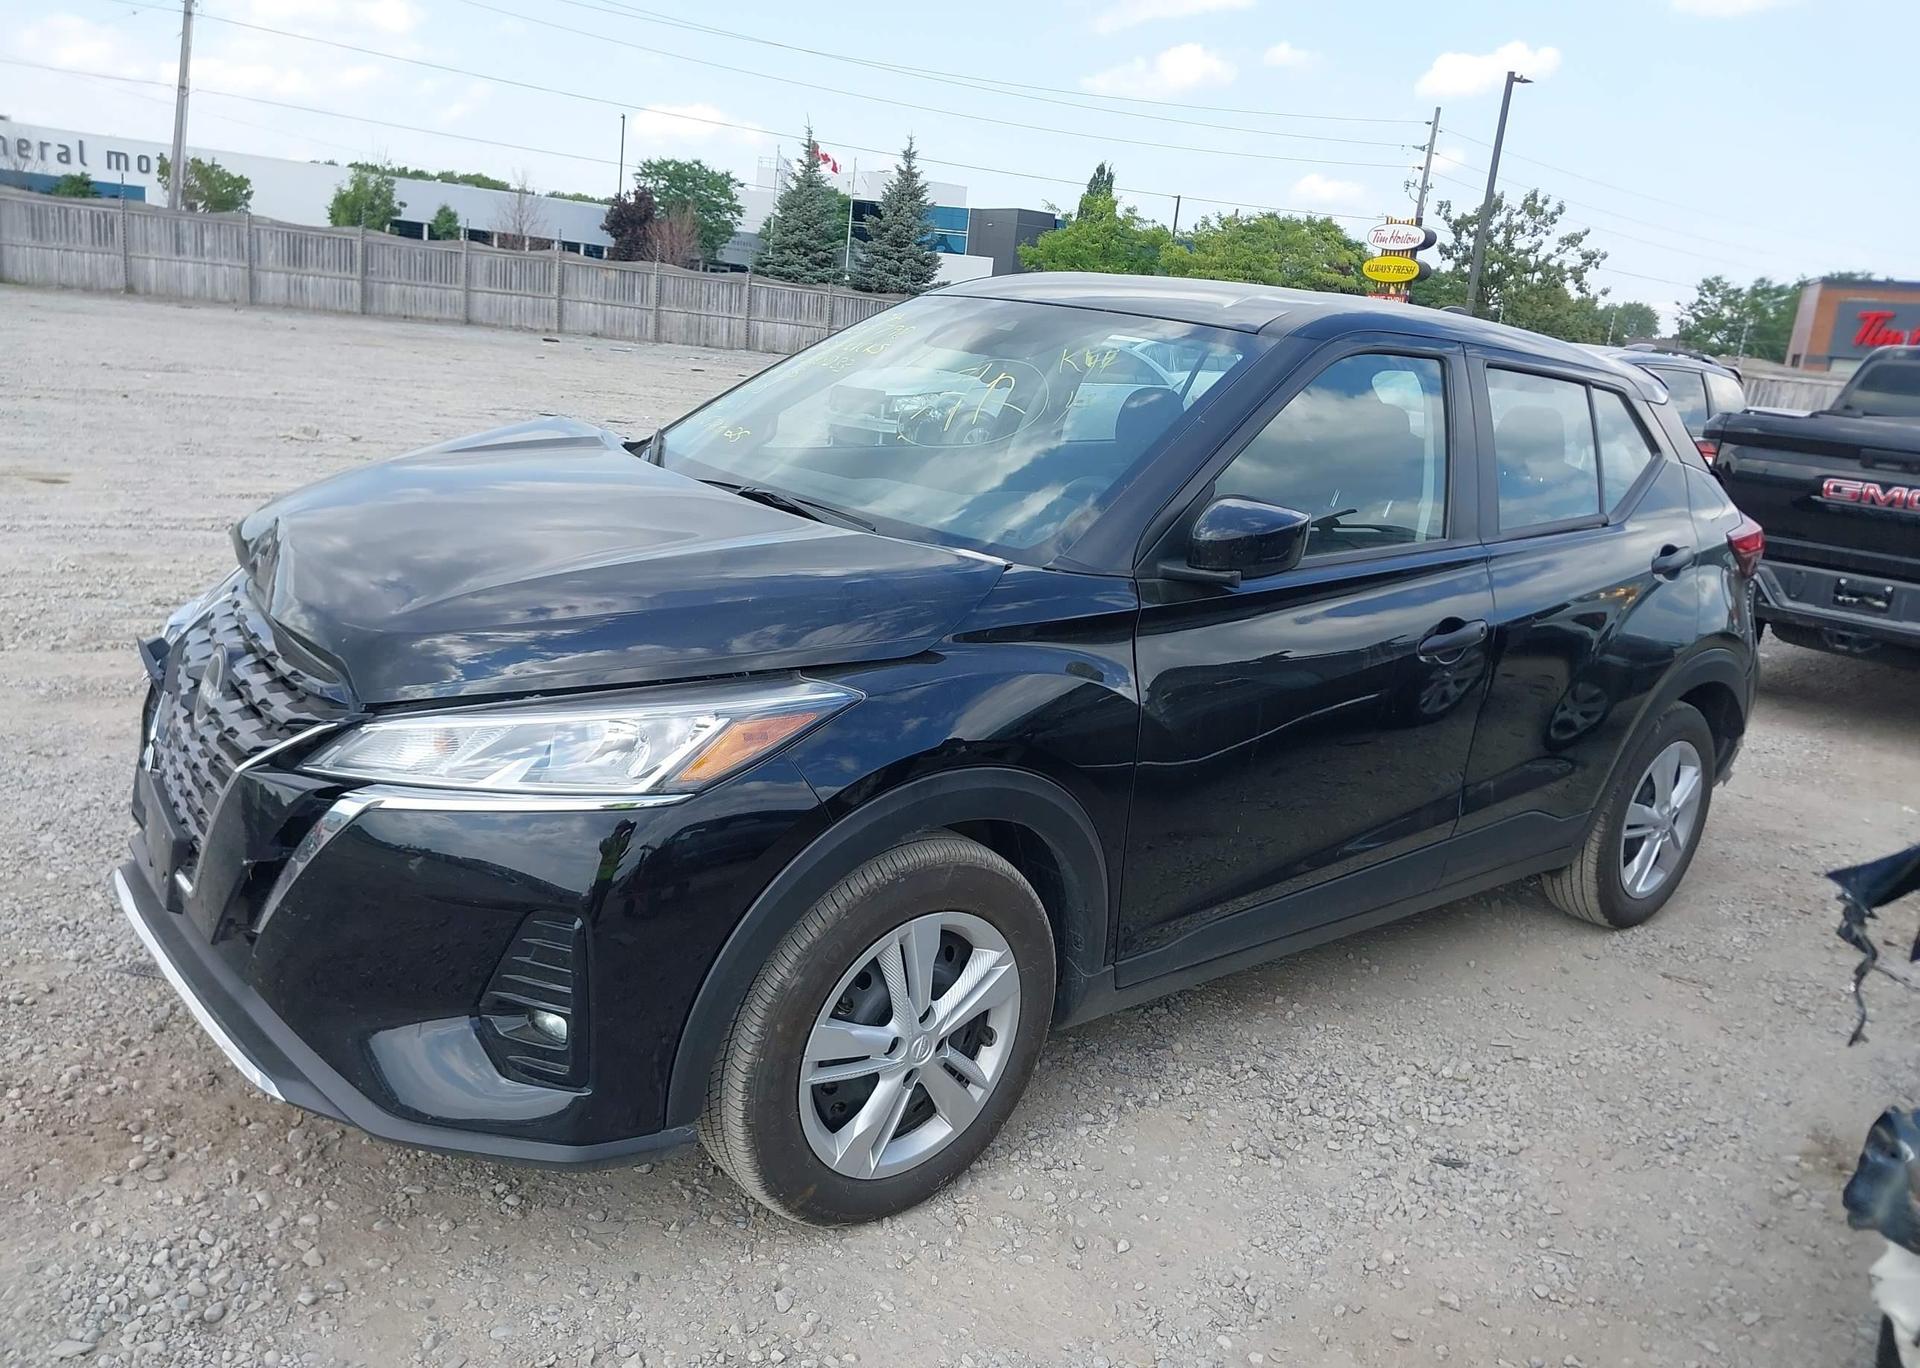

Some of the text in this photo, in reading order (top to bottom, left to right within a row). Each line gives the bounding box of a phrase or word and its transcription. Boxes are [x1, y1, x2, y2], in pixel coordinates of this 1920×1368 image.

[1373, 229, 1420, 244] Tim Hortons
[1366, 264, 1416, 275] ALWAYS FRESH
[1852, 310, 1905, 347] Tim
